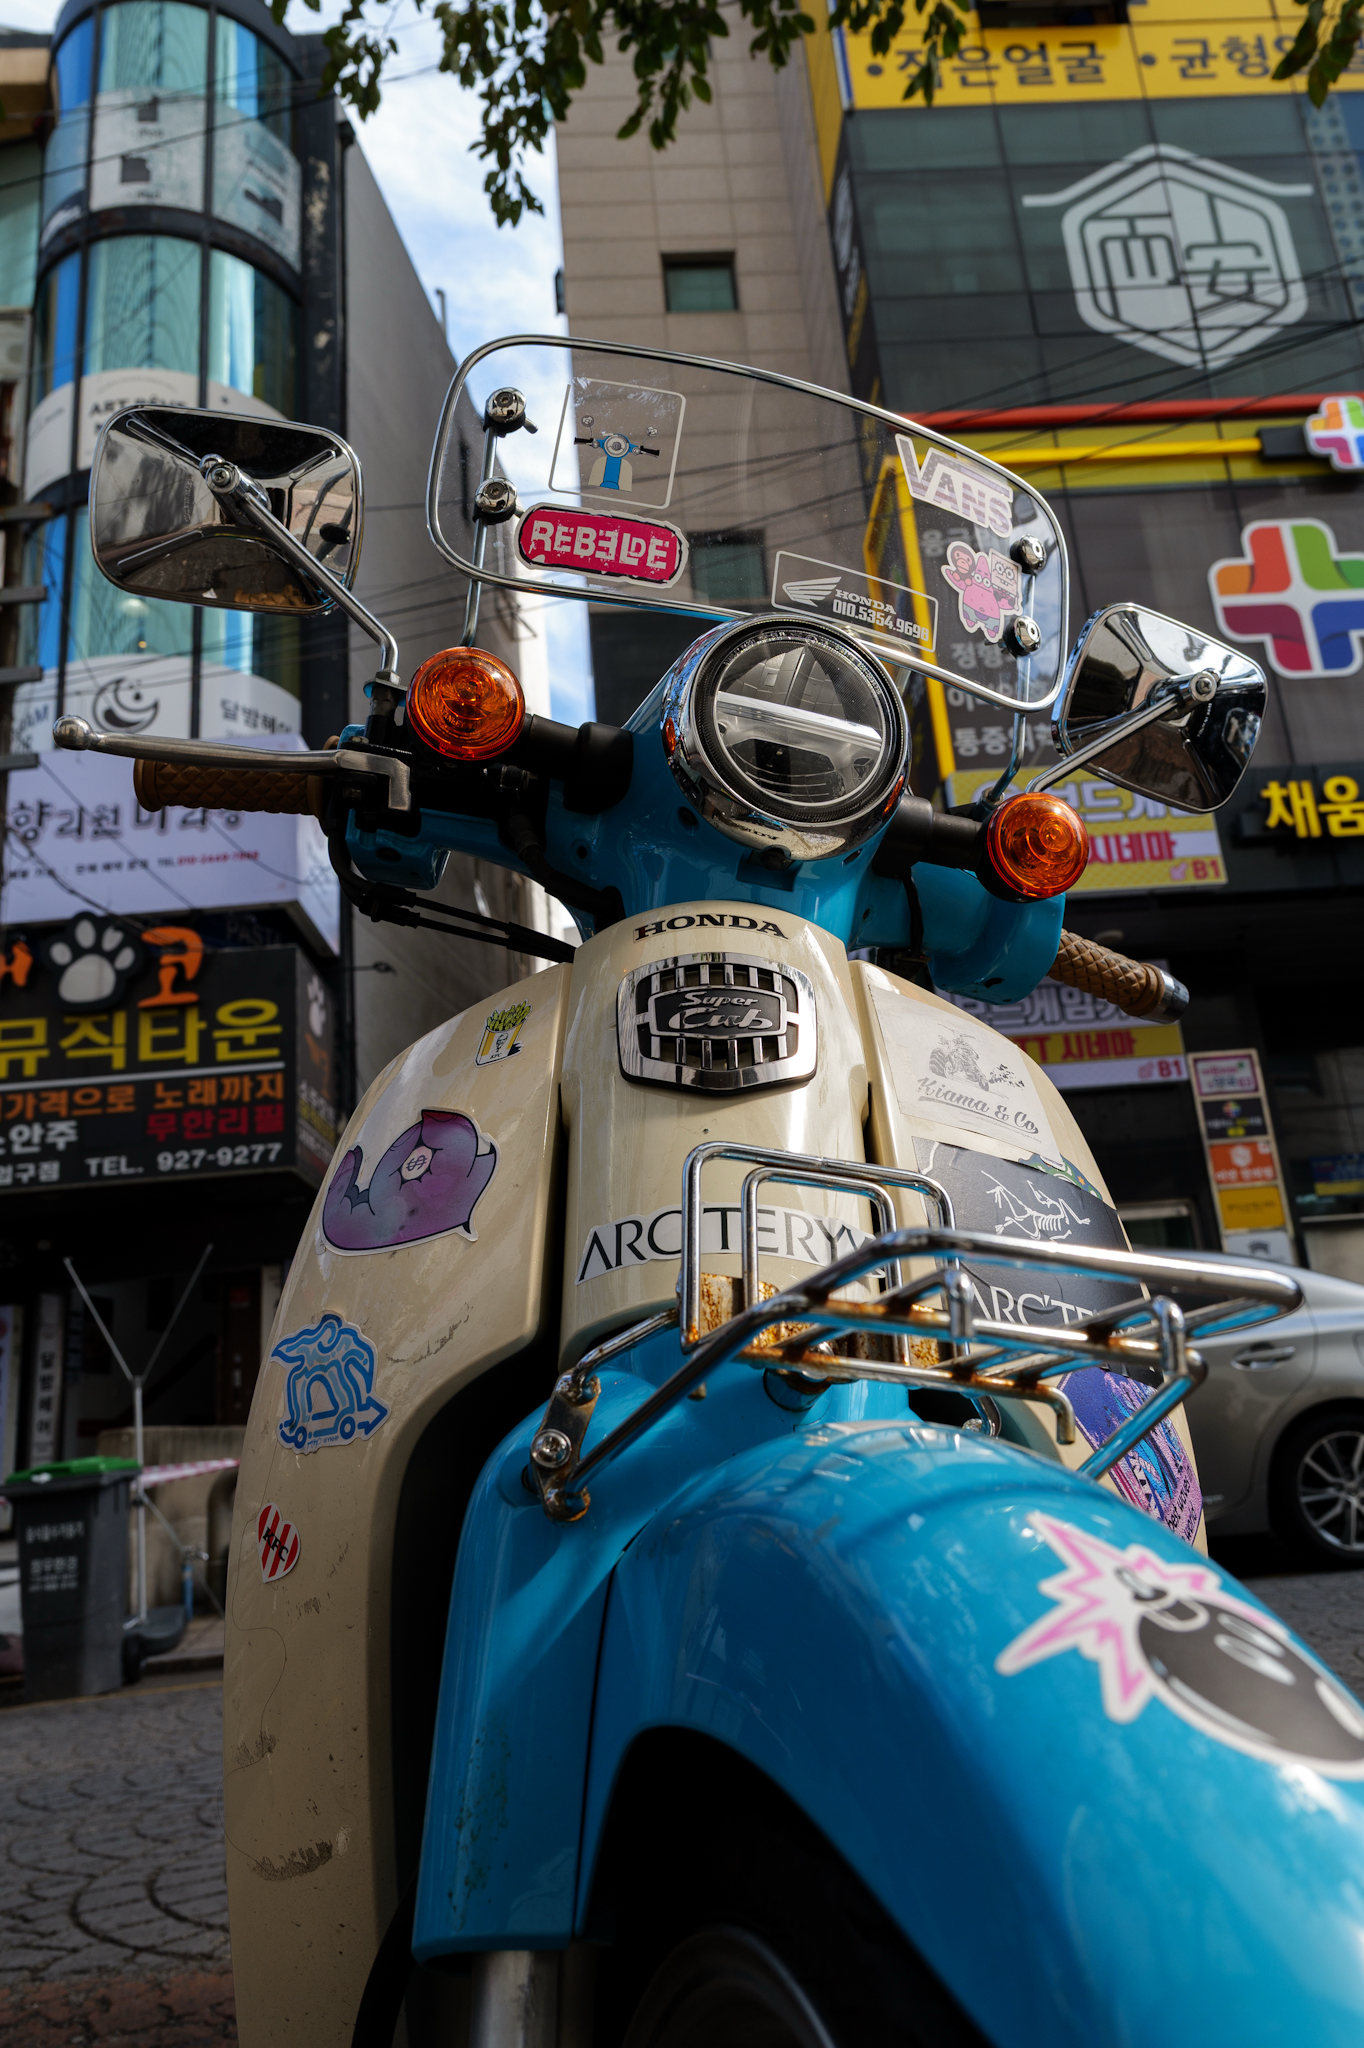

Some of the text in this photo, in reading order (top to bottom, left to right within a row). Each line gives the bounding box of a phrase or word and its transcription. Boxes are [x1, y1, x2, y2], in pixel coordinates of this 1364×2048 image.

[897, 436, 1012, 535] VANS
[531, 520, 670, 571] REBELDE
[831, 588, 897, 615] HONDA
[831, 599, 930, 642] 010.5354.9698
[1192, 860, 1221, 880] B1
[634, 914, 788, 941] HONDA
[678, 992, 759, 1007] Super
[668, 1008, 774, 1031] Cub
[0, 1000, 282, 1078] 뮤직타운
[1158, 1060, 1184, 1078] B1
[0, 1072, 284, 1120] 가격으로 노래까지
[917, 1077, 991, 1113] Kiama
[995, 1105, 1009, 1121] &
[0, 1120, 78, 1156] 안주
[146, 1103, 285, 1143] 무한리필
[156, 1142, 283, 1172] 927-9277
[262, 1527, 289, 1563] KFC
